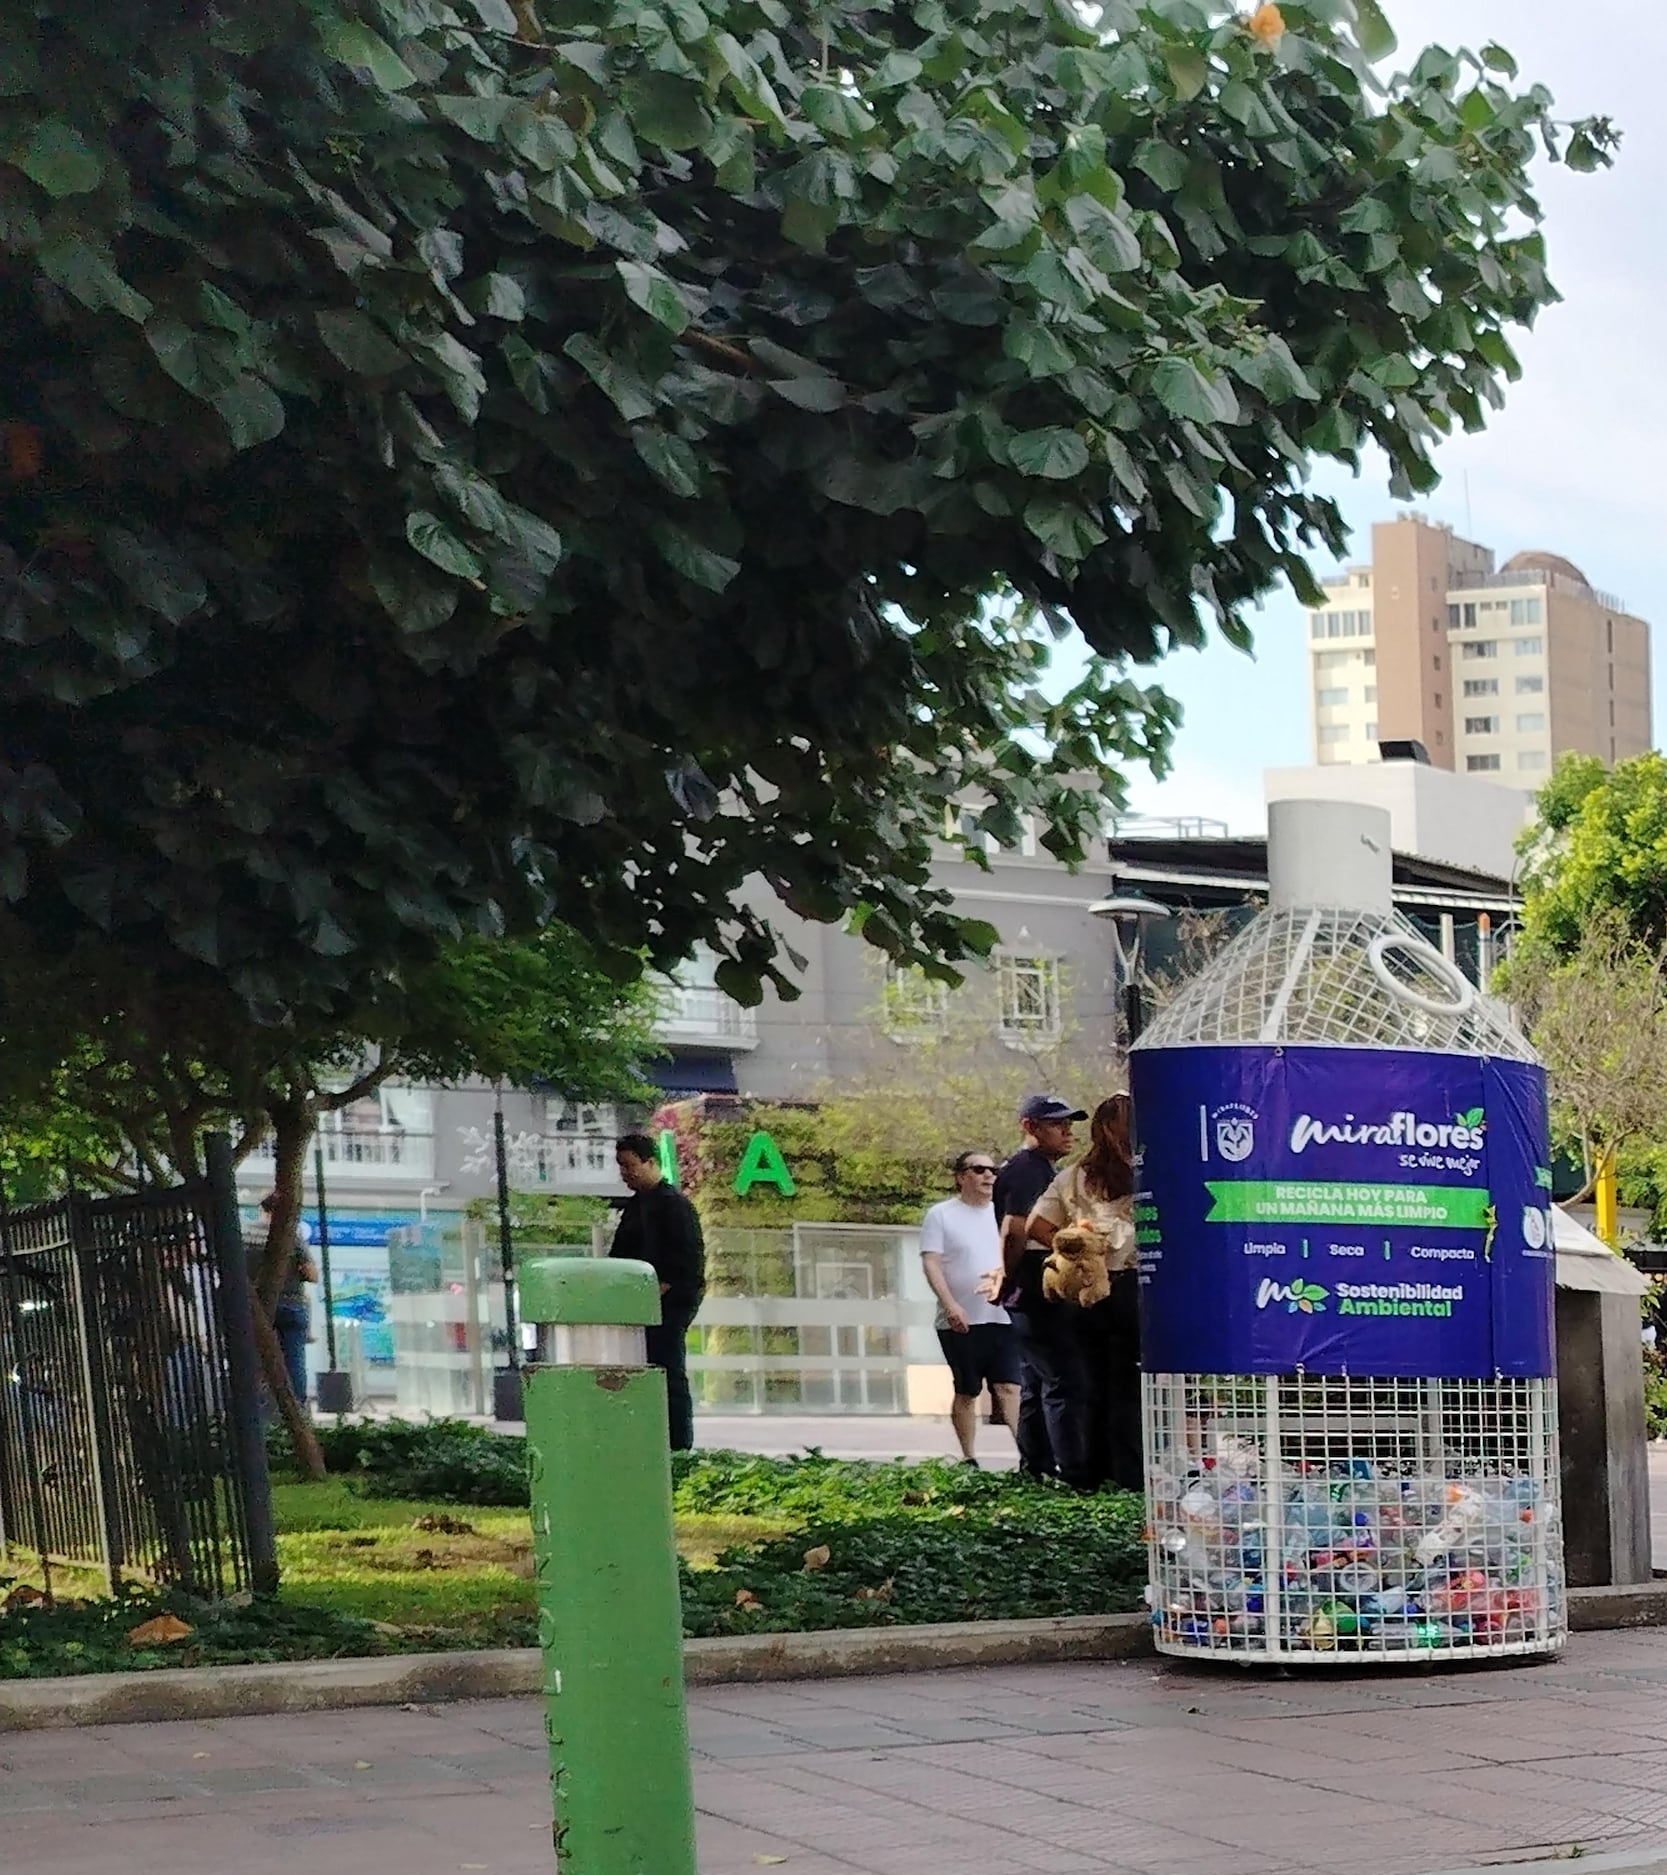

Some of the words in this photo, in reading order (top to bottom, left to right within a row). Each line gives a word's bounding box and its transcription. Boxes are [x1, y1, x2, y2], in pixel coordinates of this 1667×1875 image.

[1290, 1111, 1486, 1154] miraflores
[1399, 1153, 1419, 1169] se
[1418, 1152, 1445, 1170] vive
[1446, 1154, 1481, 1177] mejor
[1276, 1185, 1344, 1202] RECICLA
[1348, 1187, 1384, 1203] HOY
[1385, 1189, 1428, 1204] PARA
[1256, 1202, 1278, 1216] UN
[1279, 1201, 1356, 1218] MAÑANA
[1358, 1202, 1395, 1219] MÁS
[1396, 1206, 1448, 1220] LIMPIO
[1243, 1242, 1286, 1258] Limpia
[1328, 1243, 1365, 1257] Seca
[1410, 1246, 1475, 1262] Compacta
[1336, 1283, 1463, 1301] Sostenibilidad
[1338, 1299, 1452, 1317] Ambiental
